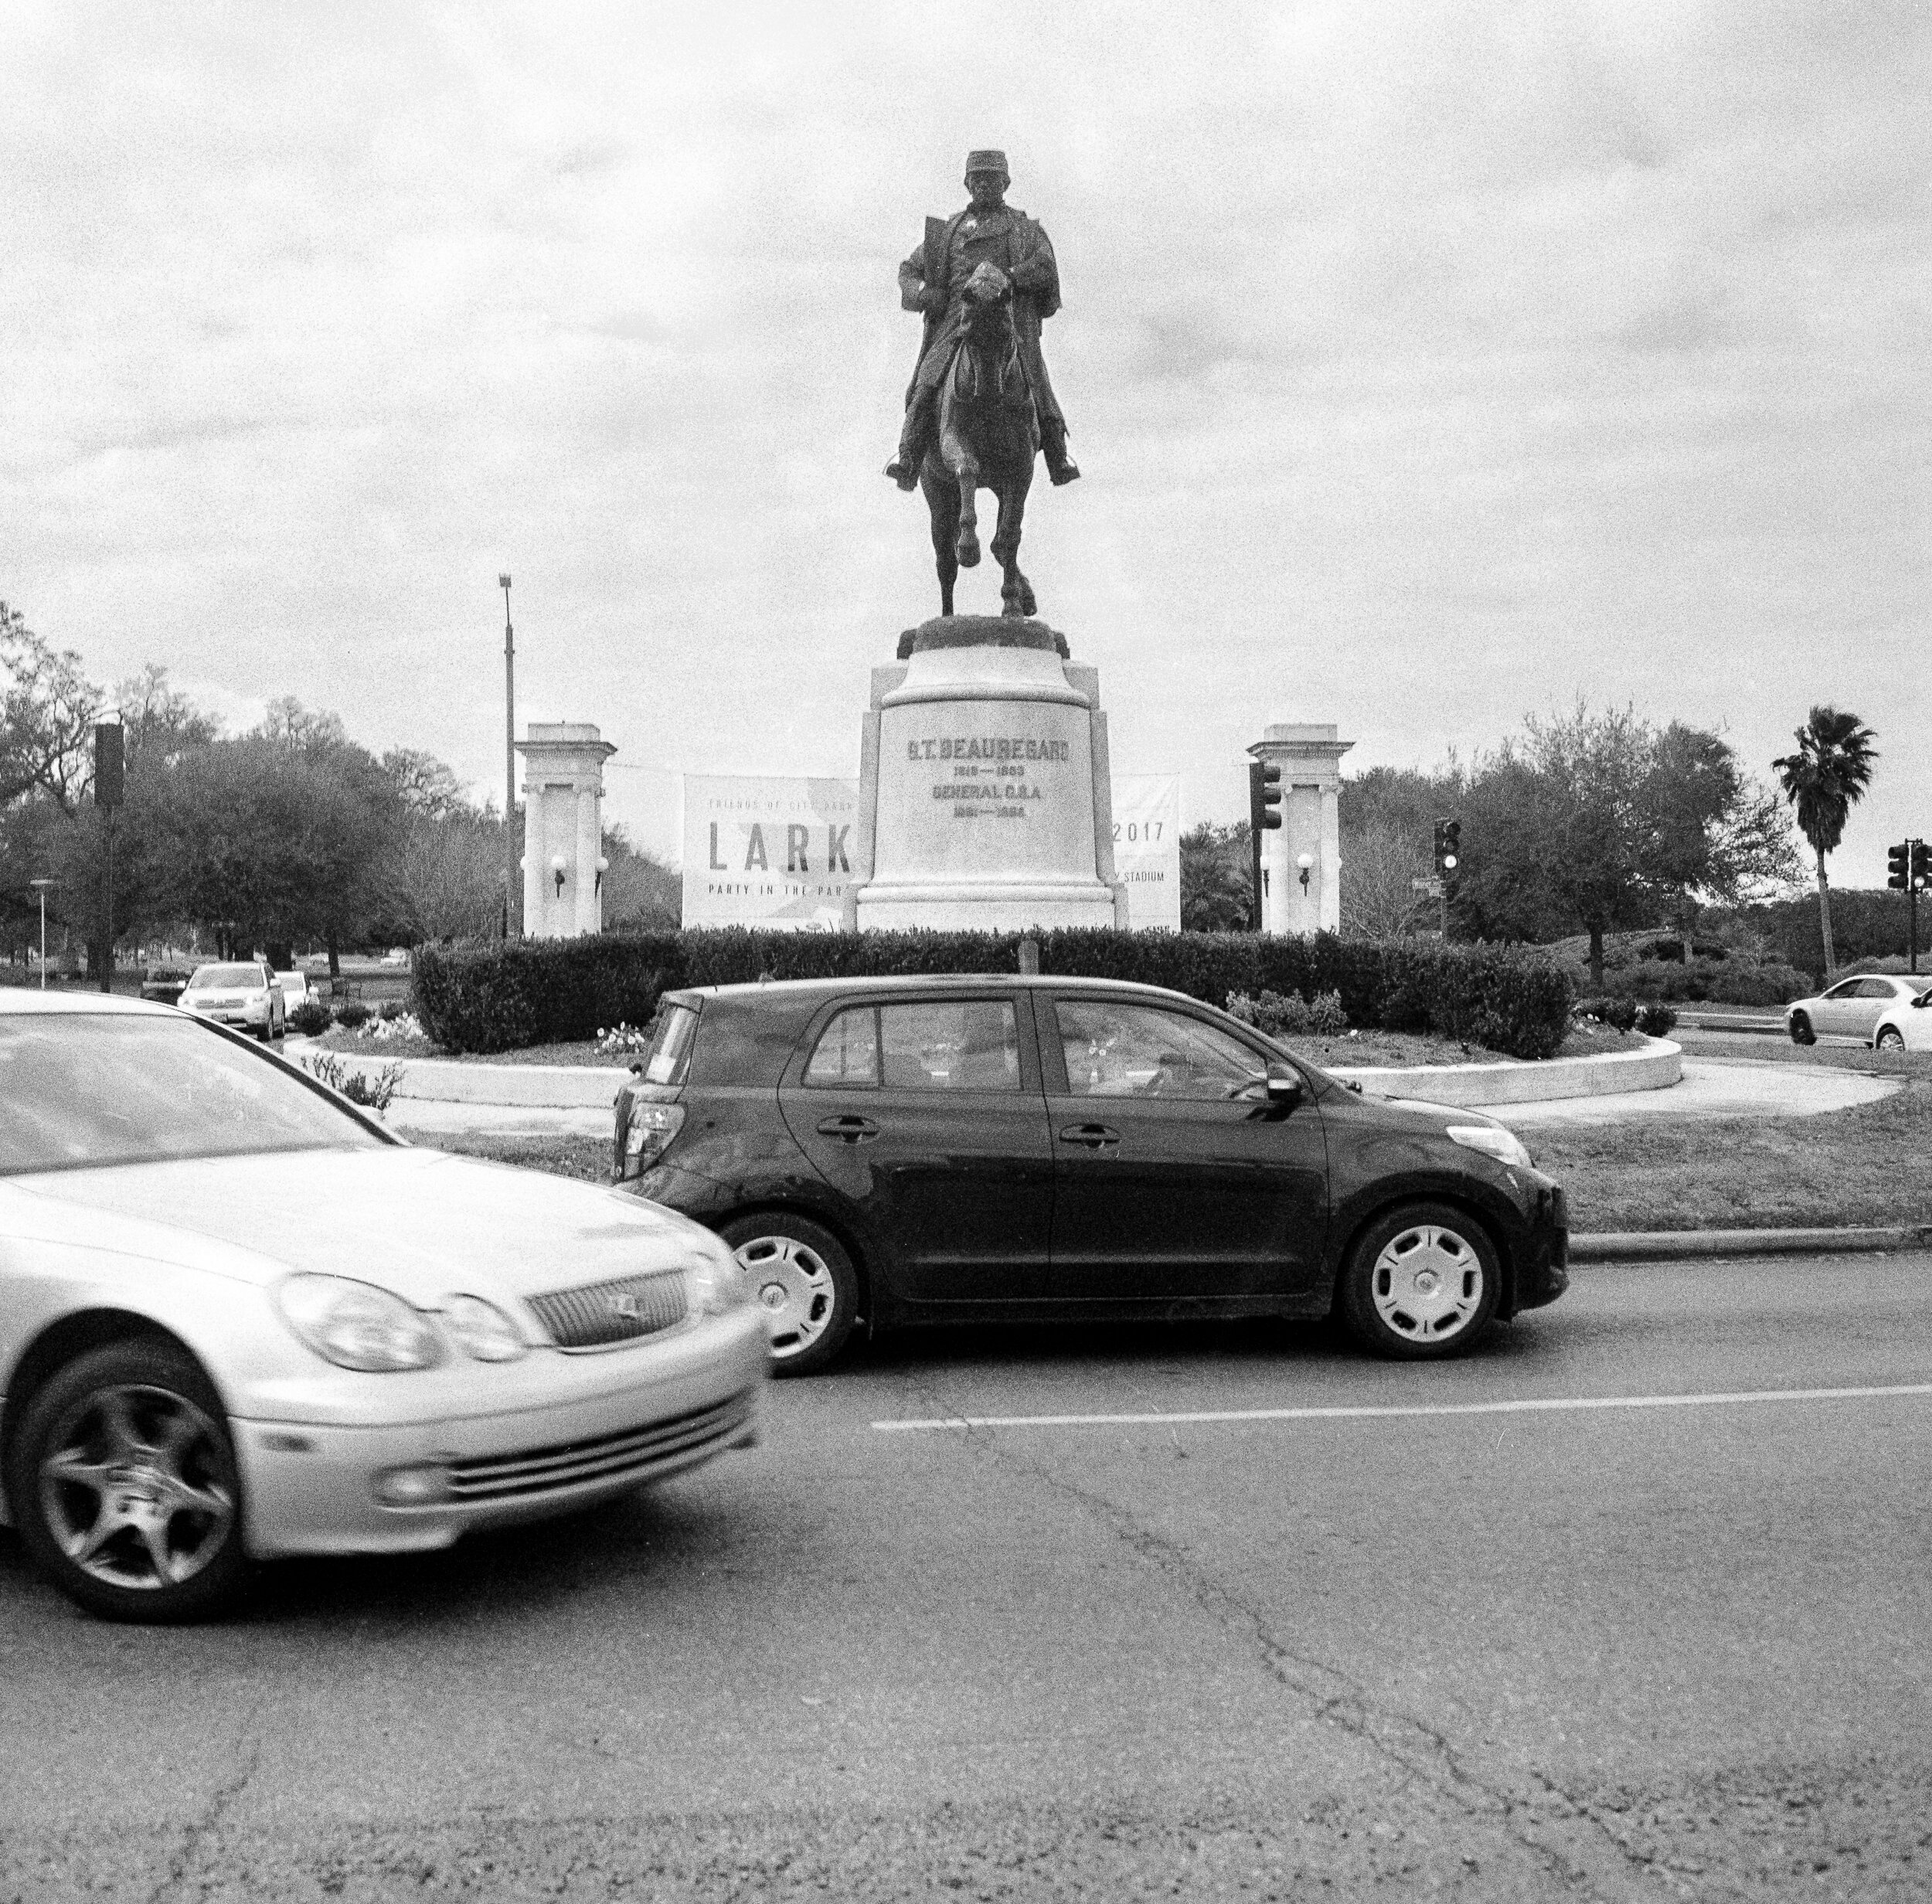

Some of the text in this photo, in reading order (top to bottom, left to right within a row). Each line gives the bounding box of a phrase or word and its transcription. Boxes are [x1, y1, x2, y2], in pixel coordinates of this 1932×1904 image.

[709, 799, 758, 809] FRIENDS
[767, 800, 780, 810] OF
[1113, 821, 1162, 842] 2017
[709, 821, 851, 873] LARK
[1124, 871, 1165, 882] STADIUM
[709, 884, 842, 896] PARTY IN THE PAR
